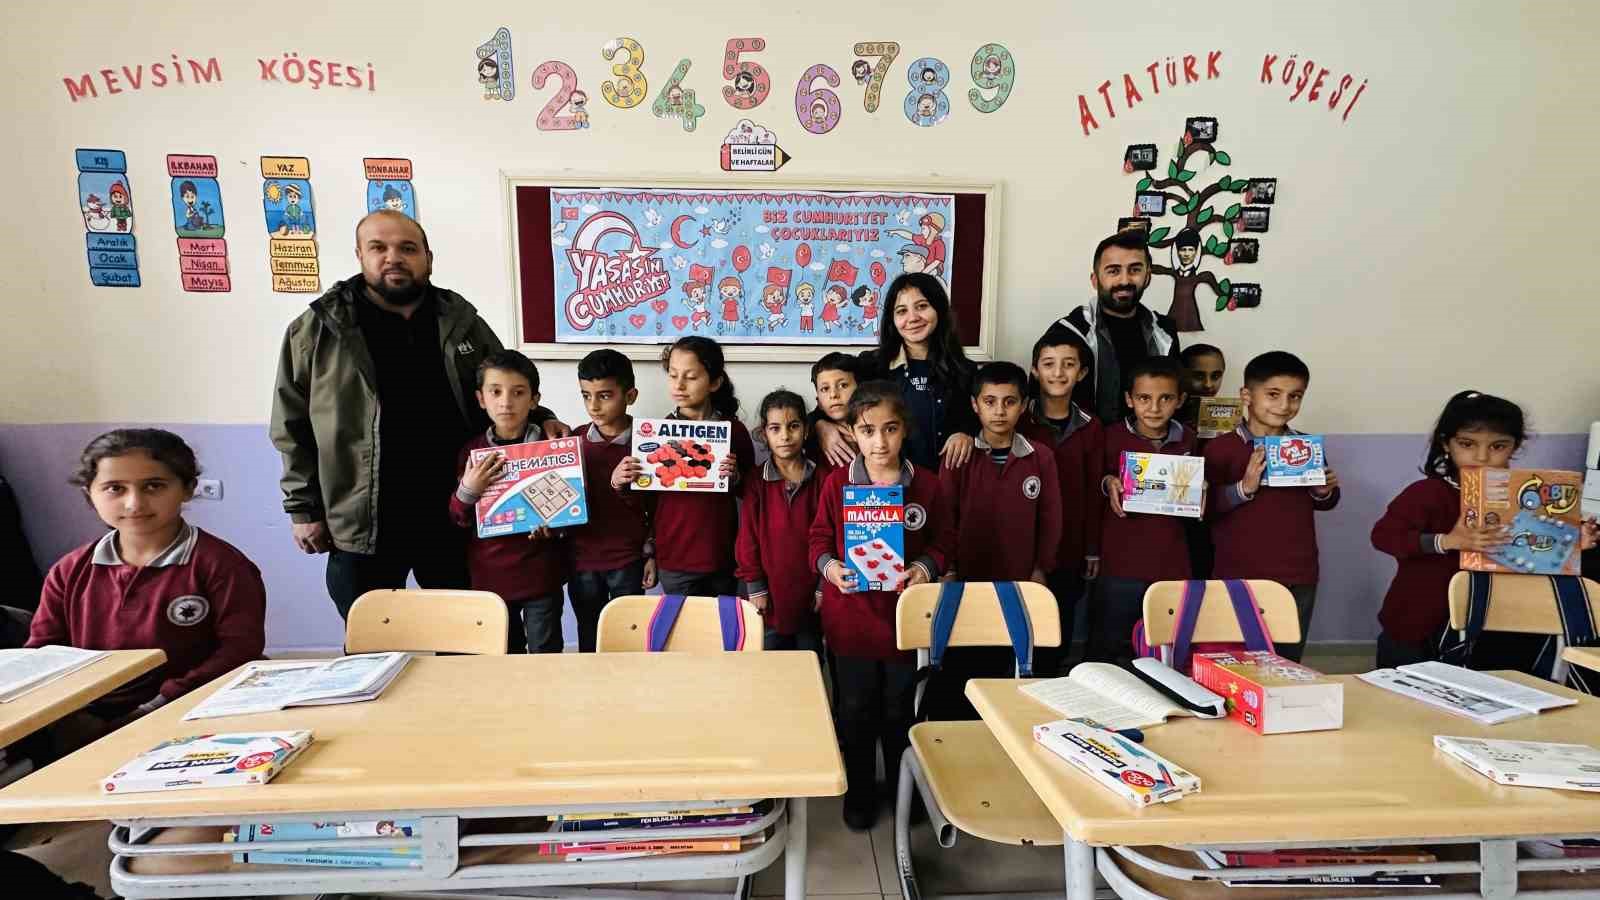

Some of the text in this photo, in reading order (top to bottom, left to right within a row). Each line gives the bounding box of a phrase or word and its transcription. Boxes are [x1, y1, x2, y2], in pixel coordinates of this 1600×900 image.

[63, 52, 375, 102] MEVSİM KÖŞESİ
[476, 27, 1015, 134] 1 2 3 4 5 6 7 8 9
[1078, 50, 1369, 135] ATATÜRK KÖŞESİ
[733, 147, 772, 155] BELİRLİ GÜN
[277, 164, 295, 172] YAZ
[367, 166, 409, 174] SONBAHAR
[97, 238, 129, 248] Aralık
[190, 243, 216, 252] Mart
[274, 243, 312, 253] Haziran
[99, 253, 128, 263] Ocak
[275, 259, 315, 270] Temmuz
[102, 272, 132, 285] Şubat
[191, 278, 224, 289] Mayıs
[279, 279, 316, 289] Ağustos
[658, 424, 728, 440] ALTIGEN
[847, 510, 900, 522] MANGALA
